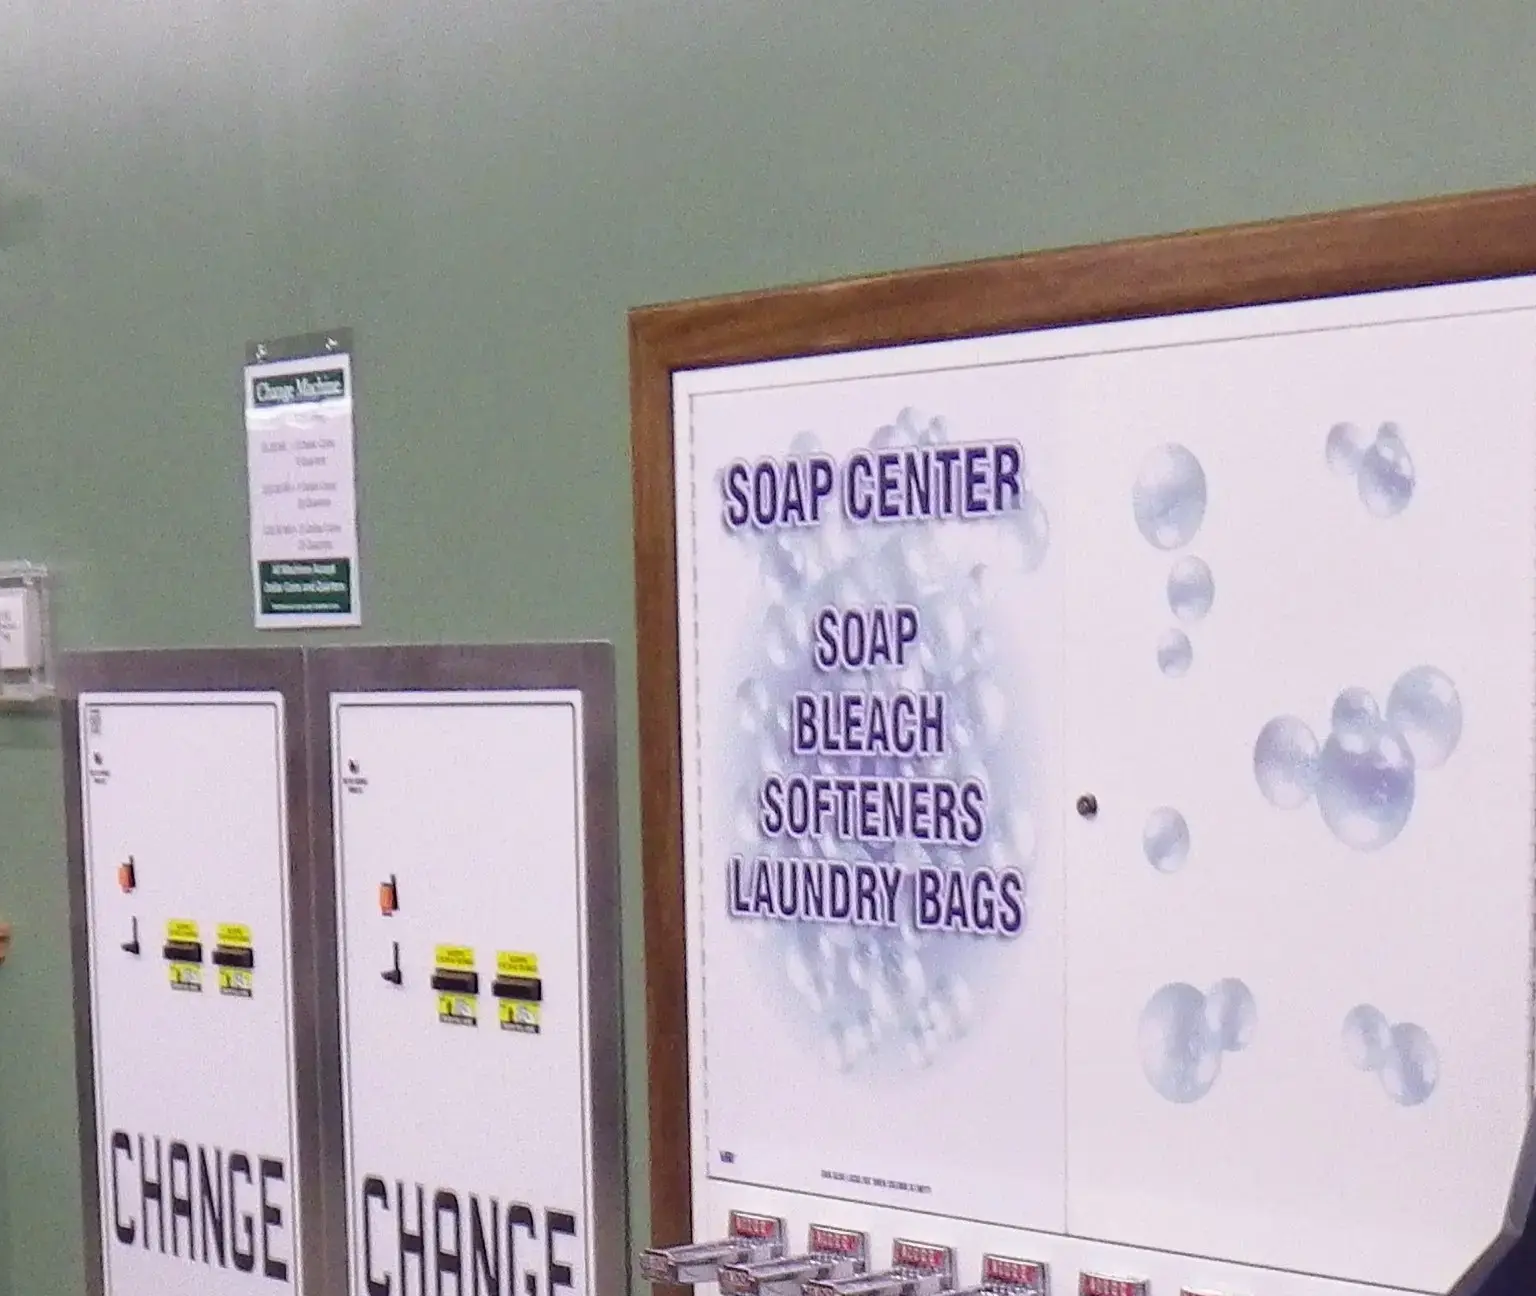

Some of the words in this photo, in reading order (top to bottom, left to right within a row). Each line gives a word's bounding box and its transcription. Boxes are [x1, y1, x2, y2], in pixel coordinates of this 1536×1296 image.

[257, 382, 295, 402] Change
[296, 376, 342, 397] Machine
[725, 457, 834, 526] SOAP
[845, 443, 1023, 521] CENTER
[816, 607, 919, 668] SOAP
[795, 693, 945, 754] BLEACH
[762, 777, 985, 843] SOFTENERS
[729, 858, 903, 924] LAUNDRY
[915, 867, 1024, 934] BAGS
[111, 1131, 290, 1282] CHANGE
